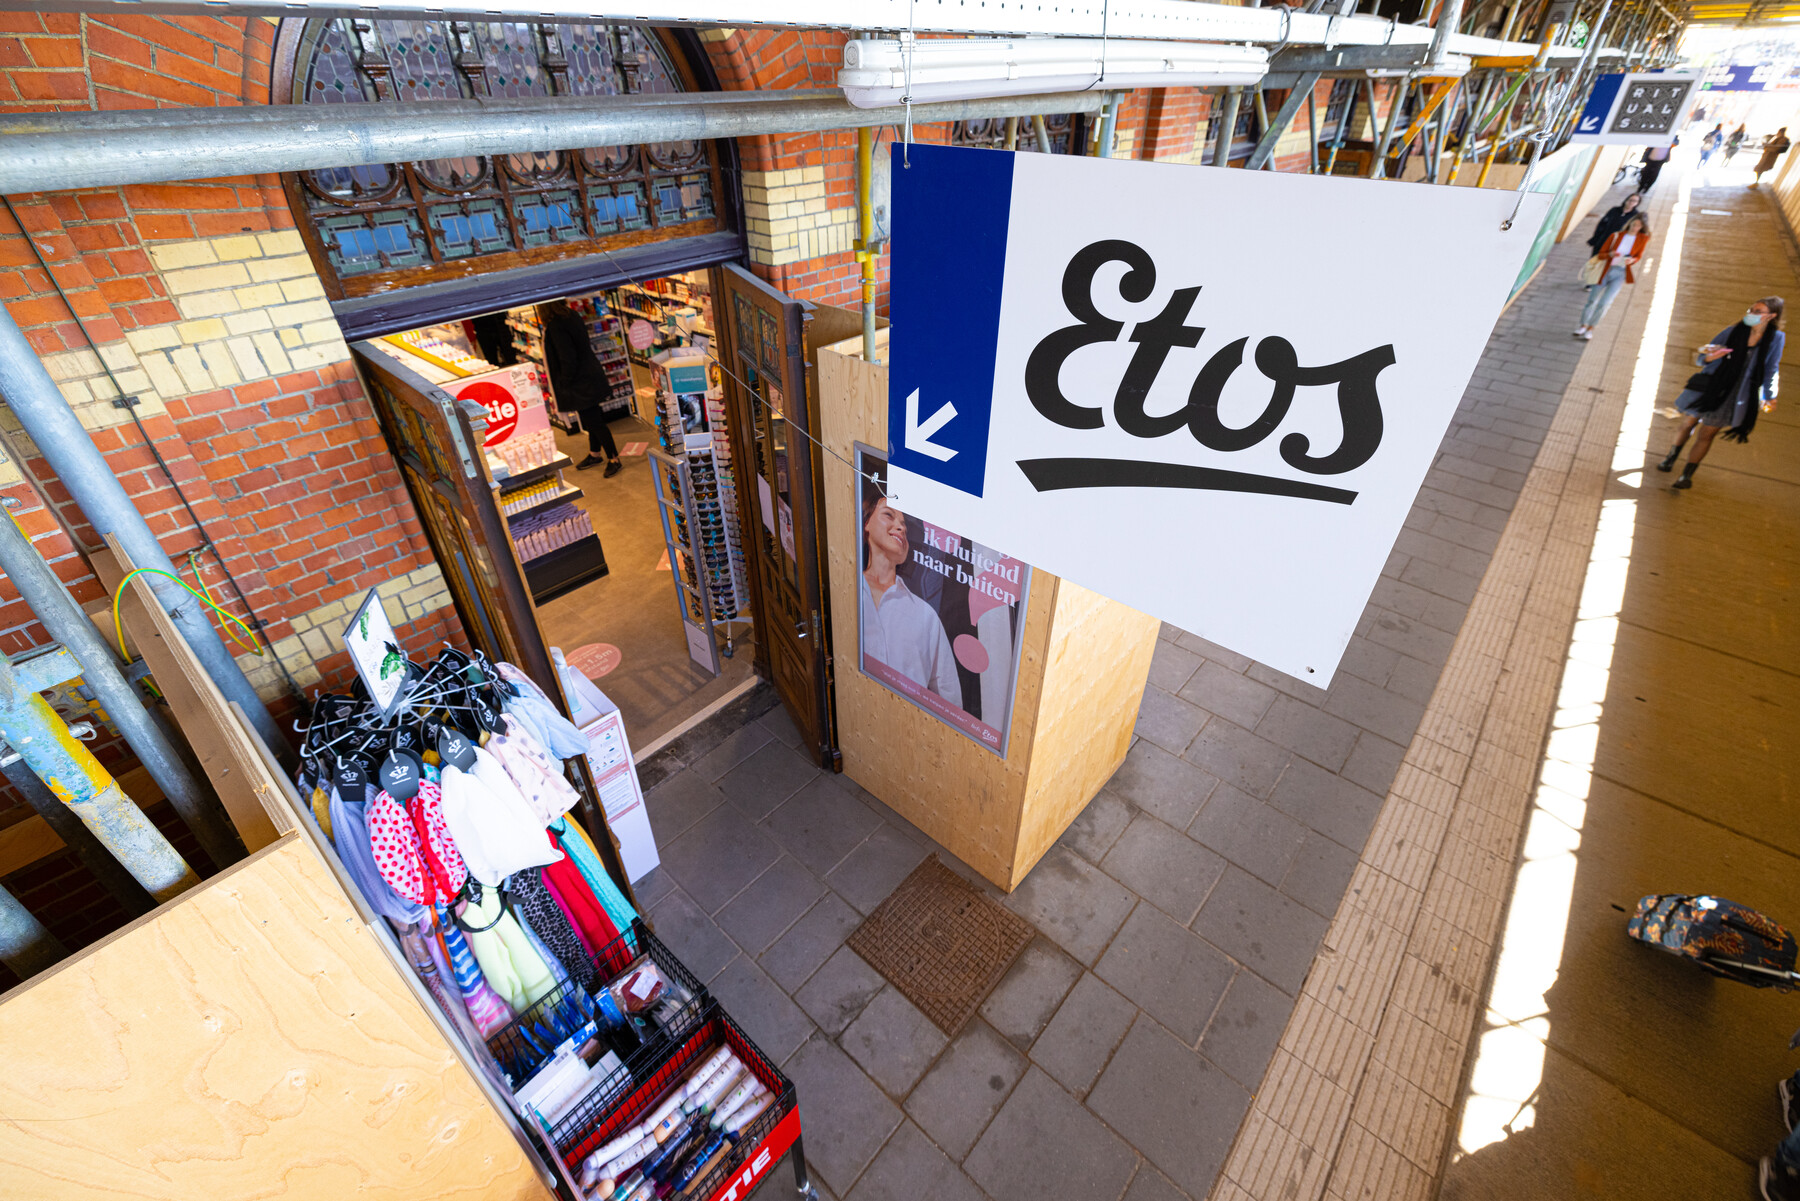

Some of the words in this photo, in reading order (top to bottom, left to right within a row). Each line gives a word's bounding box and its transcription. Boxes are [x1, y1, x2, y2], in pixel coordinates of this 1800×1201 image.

[1024, 238, 1397, 476] Etos
[913, 549, 954, 578] naar
[956, 563, 1016, 608] buiten
[923, 526, 942, 550] ik
[944, 535, 1020, 585] fluitend
[982, 729, 998, 743] Etos
[719, 1146, 772, 1201] TIE
